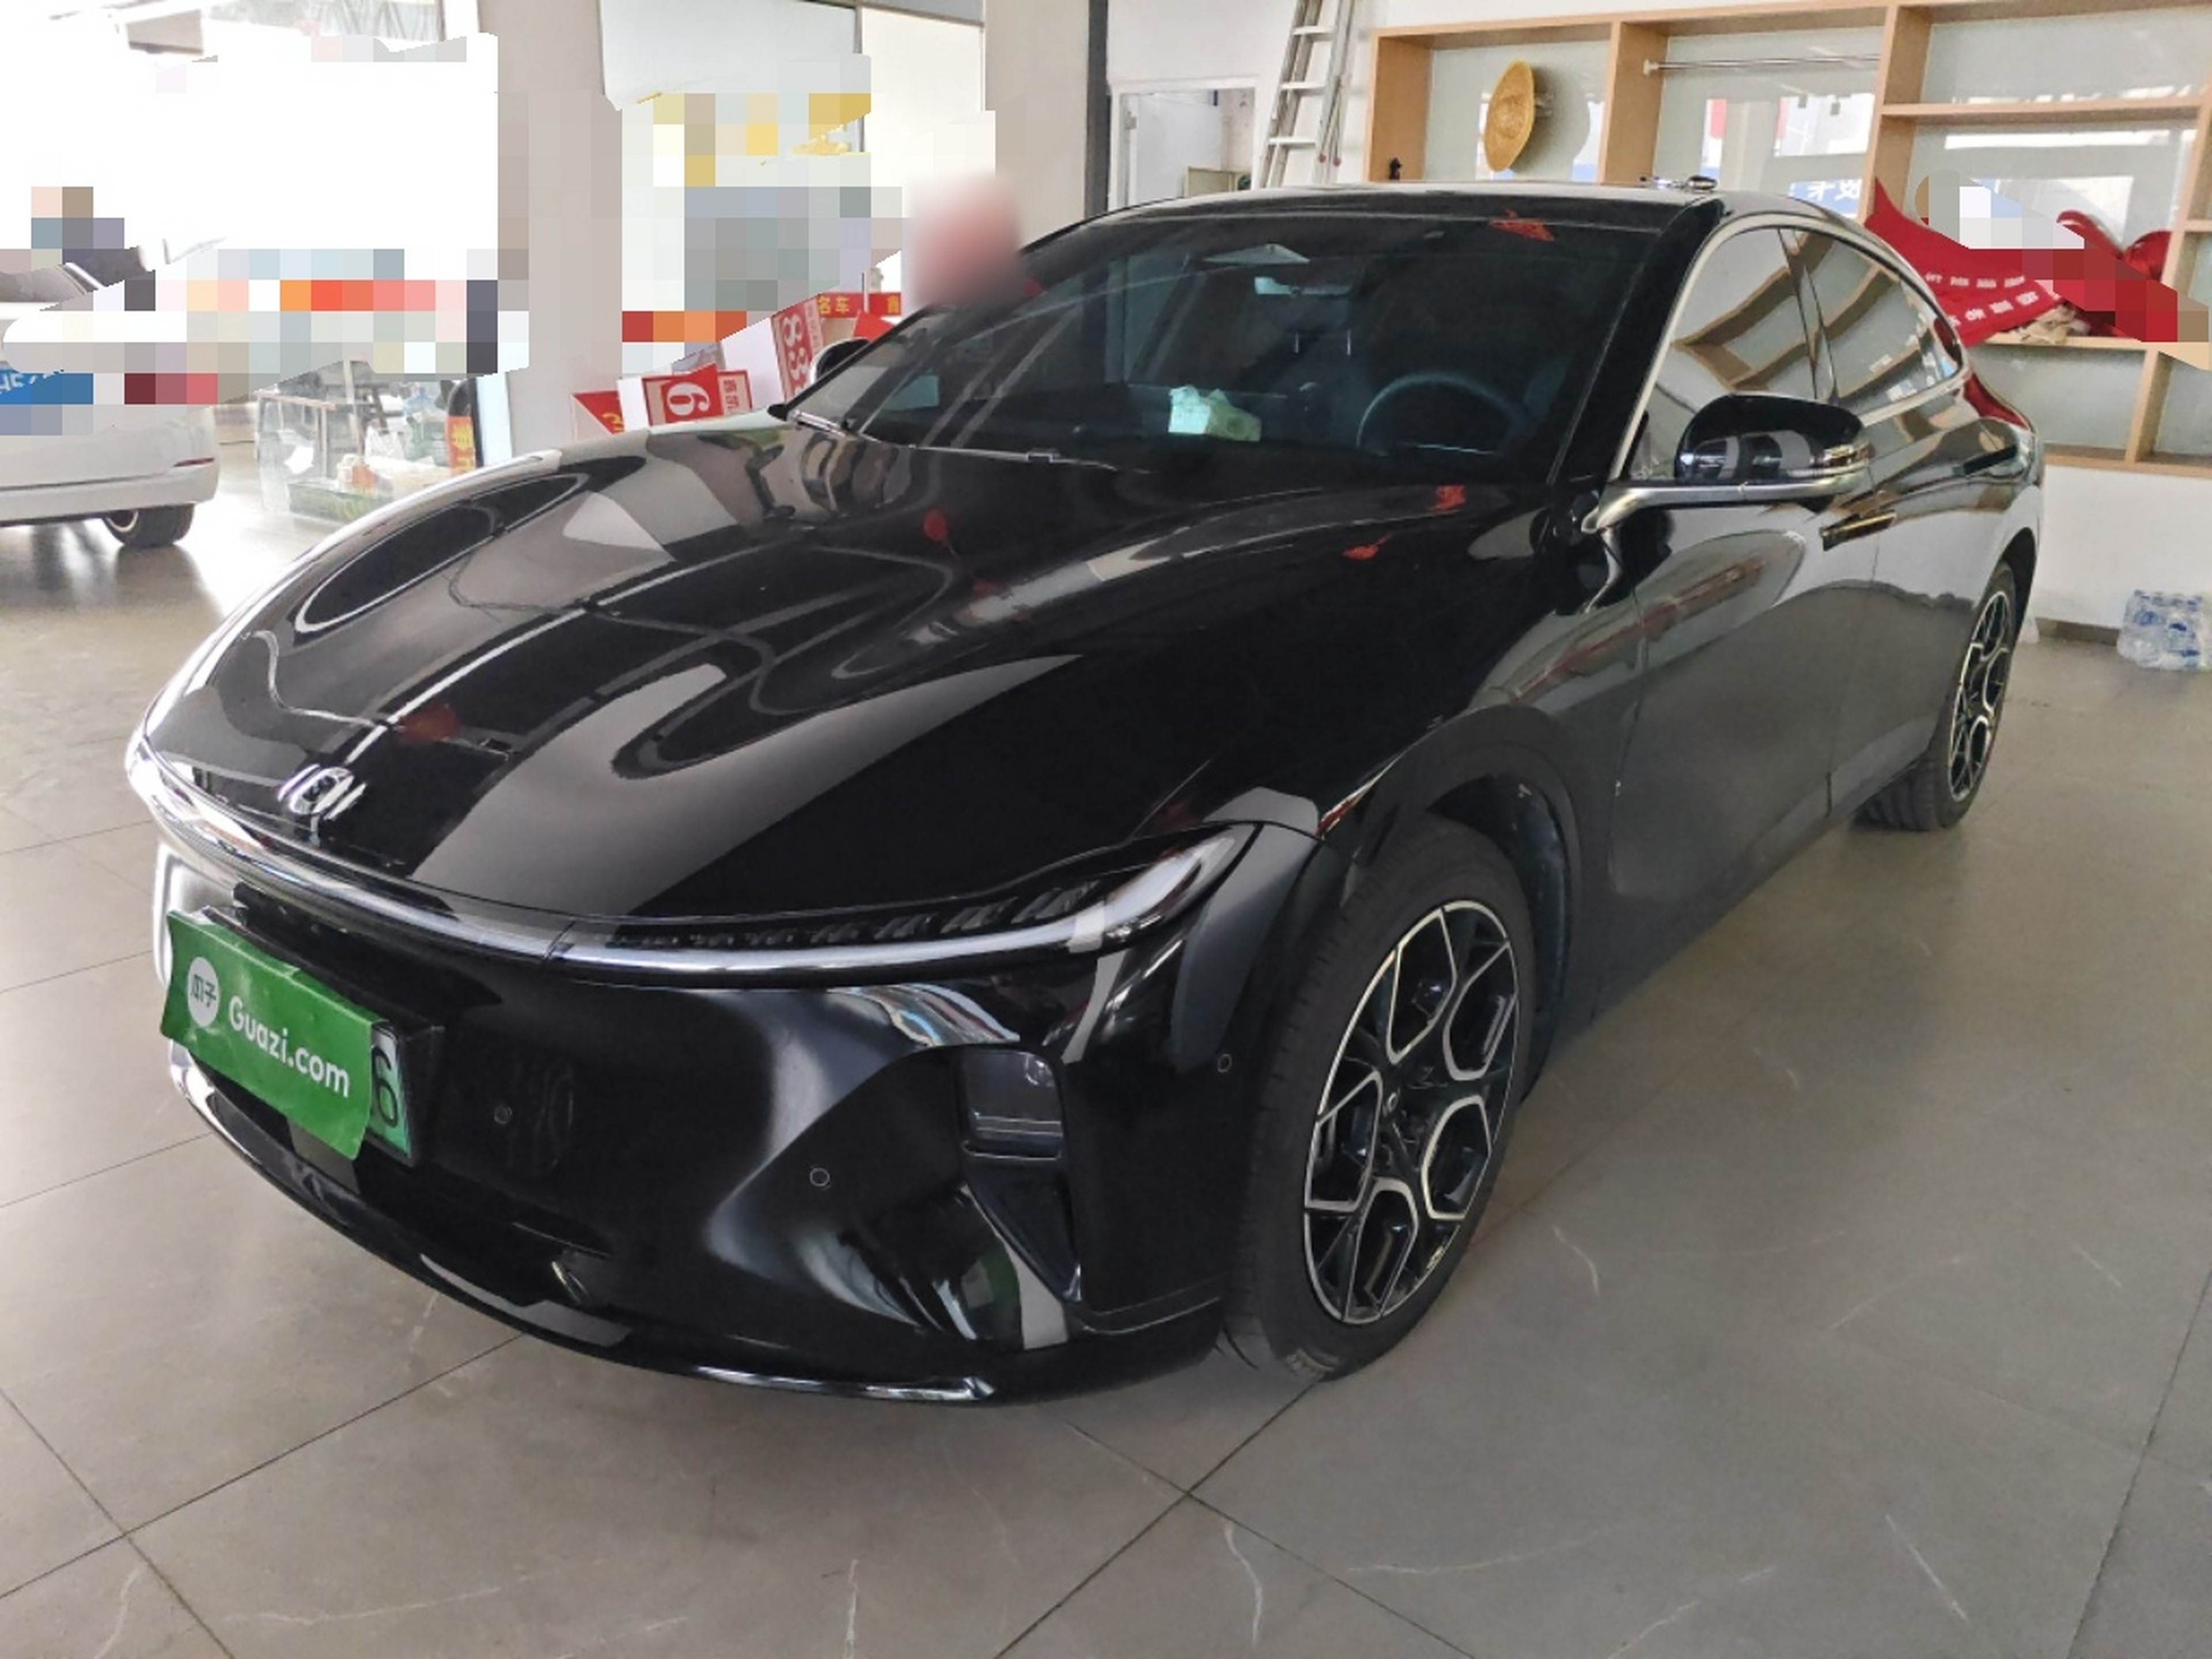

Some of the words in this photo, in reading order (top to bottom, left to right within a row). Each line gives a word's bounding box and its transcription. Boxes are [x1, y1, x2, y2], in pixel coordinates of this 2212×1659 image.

[666, 381, 710, 416] 6
[191, 974, 217, 1008] 瓜子
[229, 995, 350, 1098] Guazi.com
[372, 1046, 399, 1128] 6
